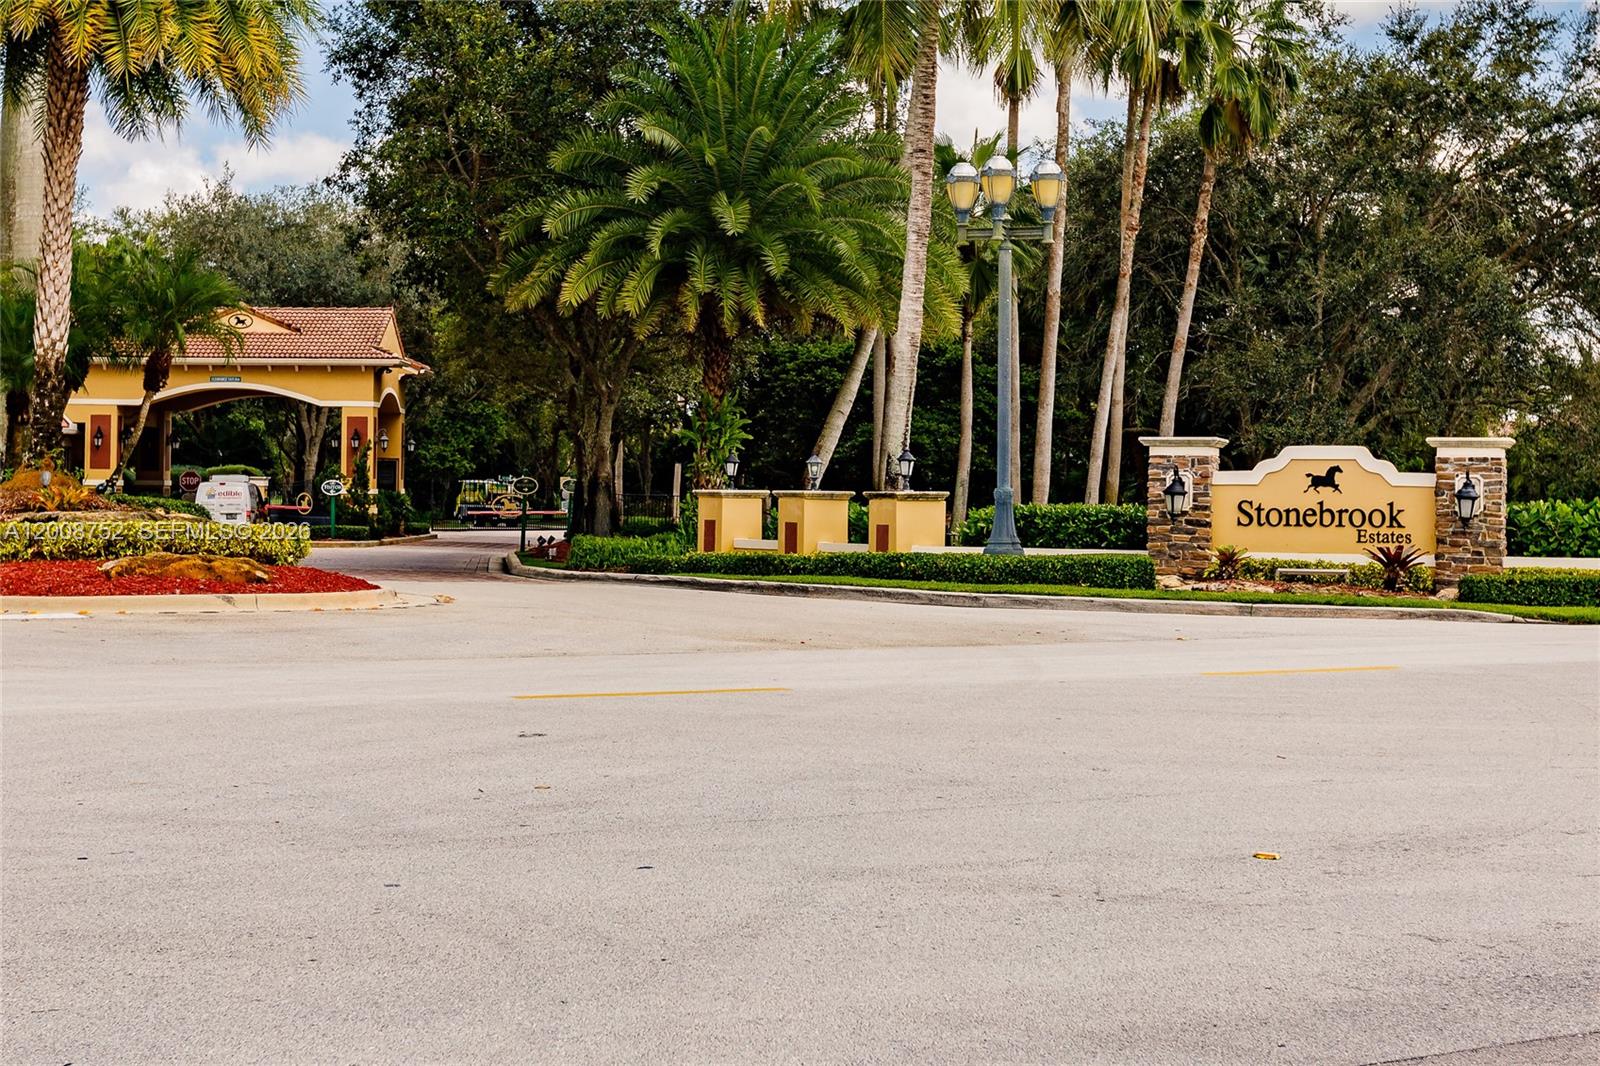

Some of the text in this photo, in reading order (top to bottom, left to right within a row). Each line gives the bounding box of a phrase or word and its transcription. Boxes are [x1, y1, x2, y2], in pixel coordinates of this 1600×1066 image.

[181, 476, 200, 485] STOP
[1236, 499, 1406, 529] Stonebrook
[1355, 528, 1413, 545] Estates
